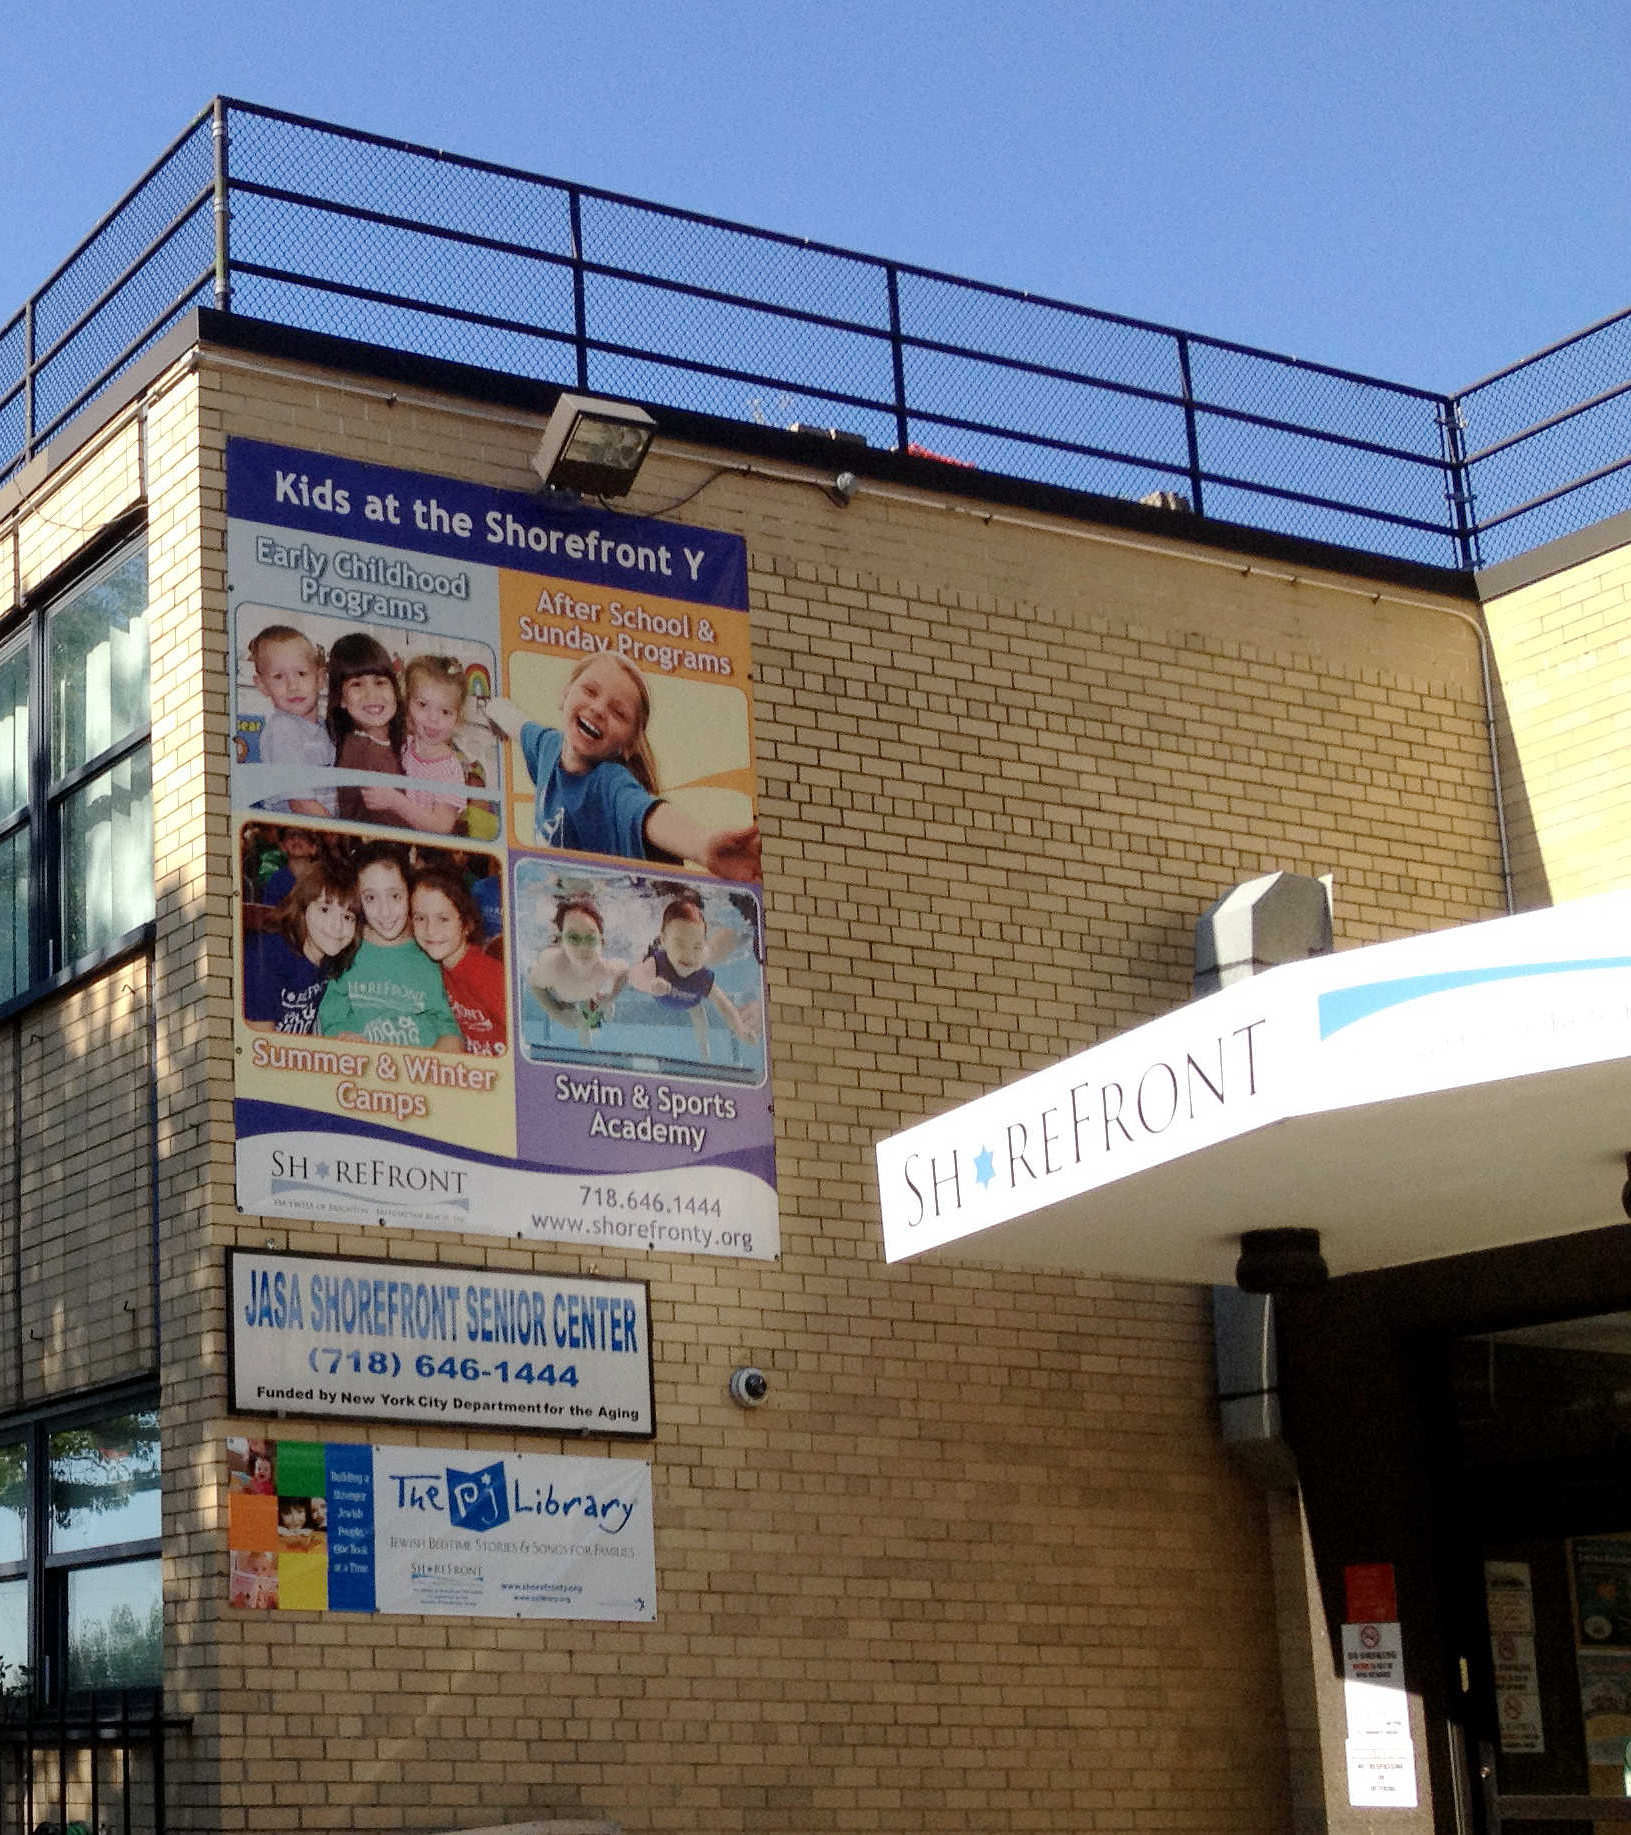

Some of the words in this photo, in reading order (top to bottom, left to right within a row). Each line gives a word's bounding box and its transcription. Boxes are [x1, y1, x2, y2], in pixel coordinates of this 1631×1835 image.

[274, 470, 351, 517] Kids
[364, 493, 402, 526] at
[414, 499, 472, 538] the
[485, 511, 672, 576] Shorefront
[683, 548, 705, 582] Y
[257, 536, 327, 579] Early
[333, 549, 469, 600] Childhood
[300, 576, 429, 623] Programs
[536, 590, 601, 624] After
[608, 603, 692, 641] School
[697, 619, 716, 644] &
[519, 616, 611, 655] Sunday
[618, 632, 732, 676] Programs
[251, 1038, 369, 1078] Summer
[376, 1051, 397, 1080] &
[404, 1055, 497, 1092] Winter
[337, 1080, 428, 1121] Camps
[555, 1075, 626, 1107] Swim
[632, 1084, 651, 1110] &
[658, 1085, 737, 1120] Sports
[589, 1111, 706, 1152] Academy
[579, 1185, 722, 1219] 718.646.1444
[531, 1211, 753, 1252] www.shorefronty.org
[245, 1269, 303, 1331] JASA
[310, 1274, 460, 1342] SHOREFRONT
[466, 1285, 547, 1346] SENIOR
[553, 1292, 638, 1354] CENTER
[308, 1347, 402, 1378] (718)
[415, 1355, 580, 1388] 646-1444
[257, 1385, 314, 1401] Funded
[318, 1388, 337, 1404] by
[341, 1391, 375, 1406] New
[380, 1392, 415, 1408] York
[417, 1394, 448, 1412] City
[452, 1397, 542, 1416] Department
[543, 1401, 565, 1416] for
[569, 1403, 593, 1418] the
[598, 1405, 640, 1423] Aging
[389, 1474, 445, 1512] The
[514, 1478, 635, 1534] Library
